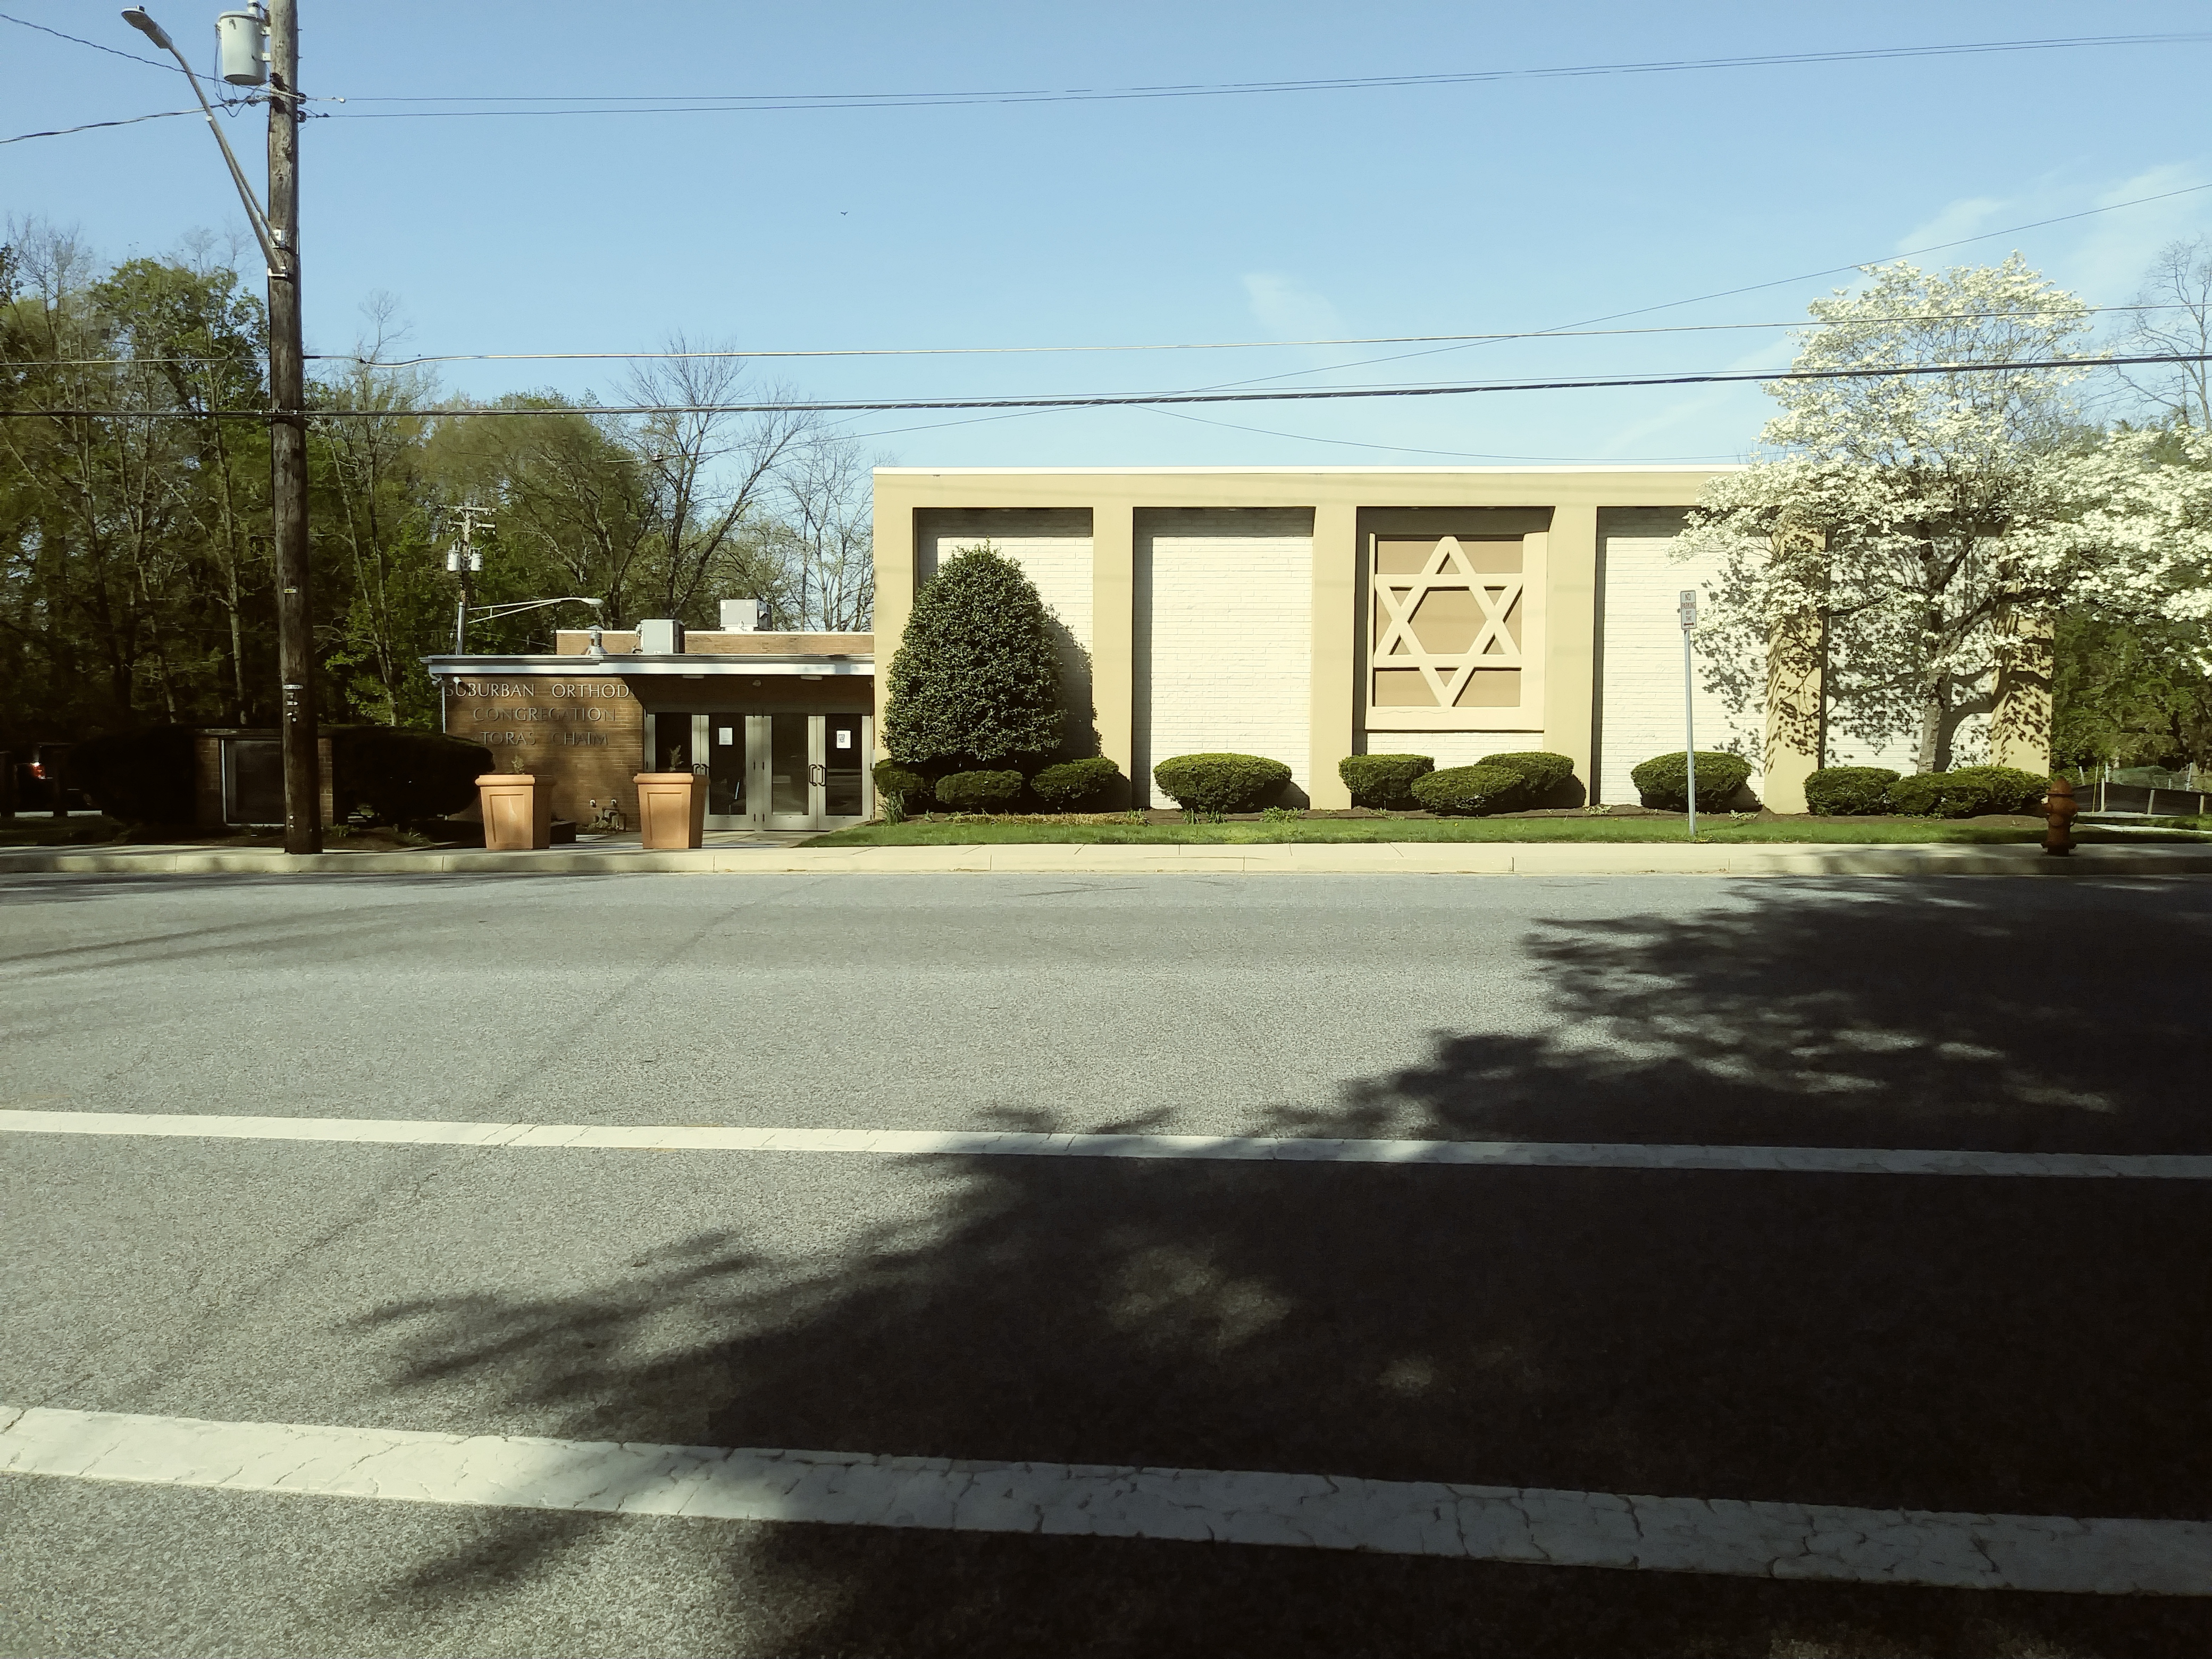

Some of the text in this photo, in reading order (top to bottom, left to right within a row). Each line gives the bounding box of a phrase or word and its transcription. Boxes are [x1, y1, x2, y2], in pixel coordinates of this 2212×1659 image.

[446, 683, 636, 698] SUBURBAN ORTHOD
[473, 707, 616, 722] CONGREGATION
[481, 732, 609, 745] TORAS CHAIM
